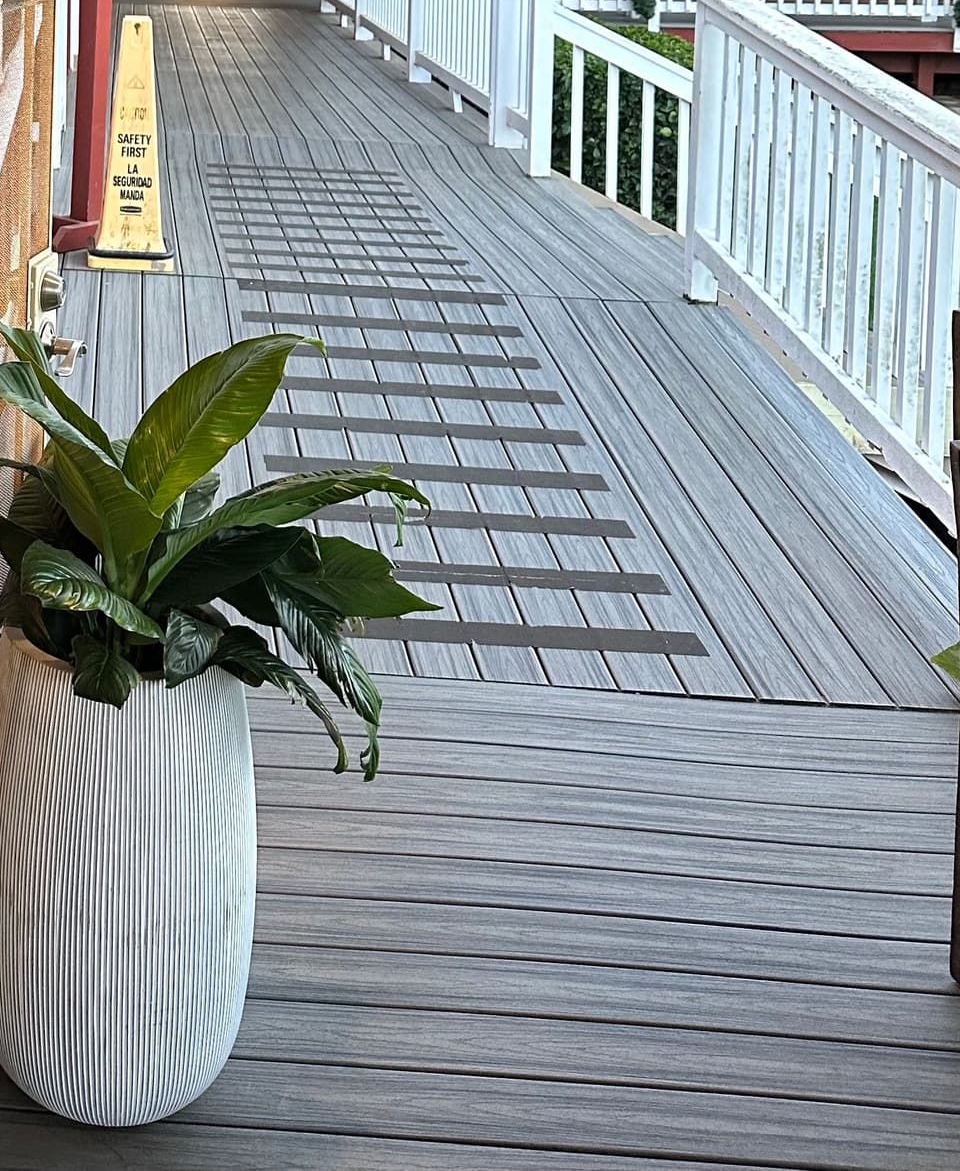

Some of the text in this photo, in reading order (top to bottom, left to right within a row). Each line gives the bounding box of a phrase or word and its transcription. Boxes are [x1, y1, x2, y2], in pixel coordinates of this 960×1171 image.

[117, 133, 152, 145] SAFETY
[121, 146, 147, 158] FIRST
[127, 163, 139, 174] LA
[113, 175, 152, 189] SEGURIDAD
[120, 189, 144, 201] MANDA
